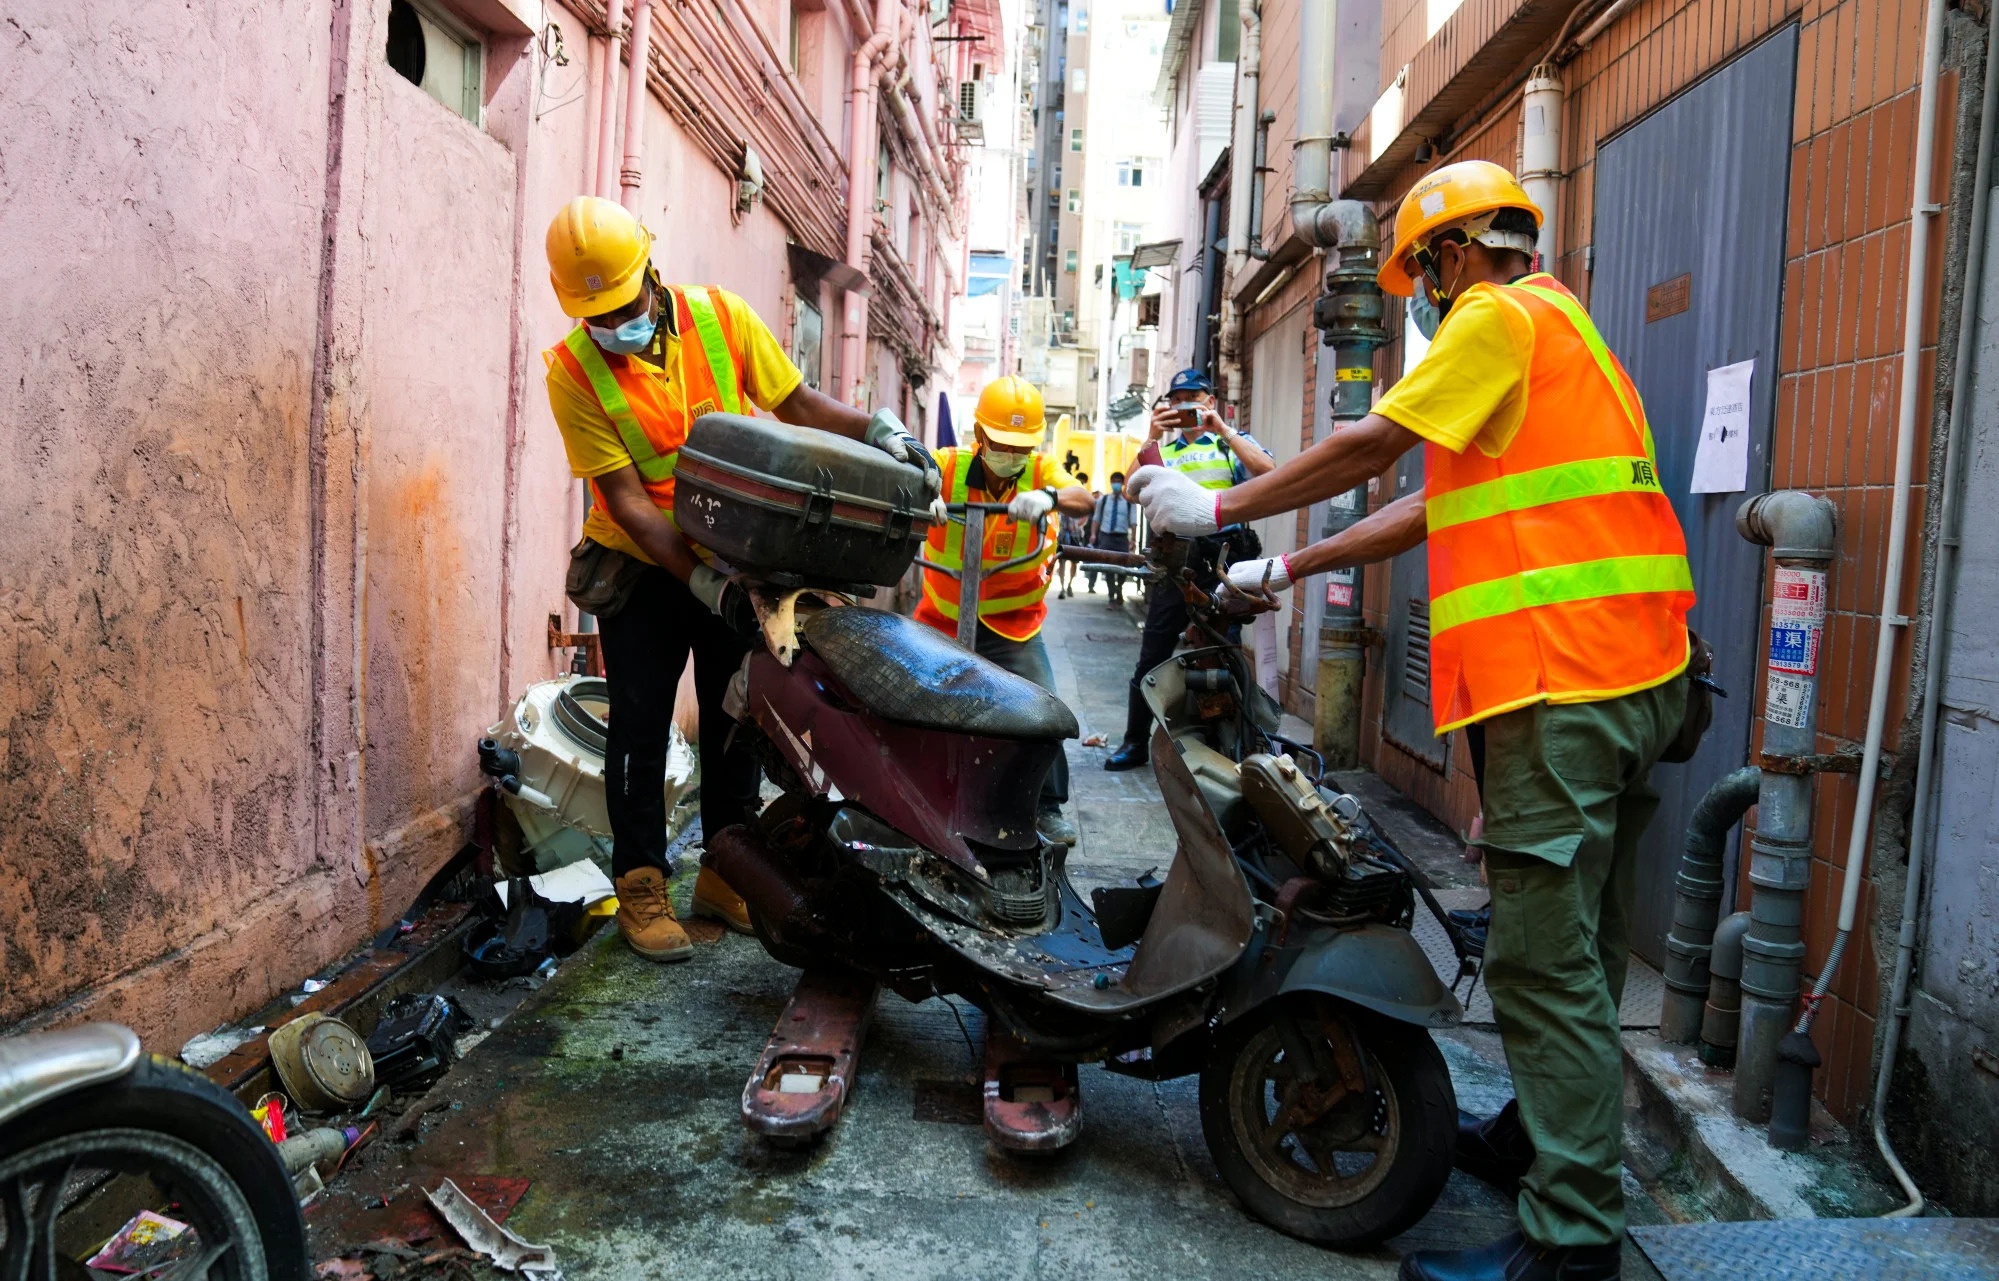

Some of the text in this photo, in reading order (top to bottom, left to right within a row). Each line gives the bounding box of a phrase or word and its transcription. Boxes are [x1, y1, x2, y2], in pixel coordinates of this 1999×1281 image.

[1176, 452, 1205, 465] POLICE
[1630, 460, 1656, 486] 順
[1784, 630, 1802, 648] 渠
